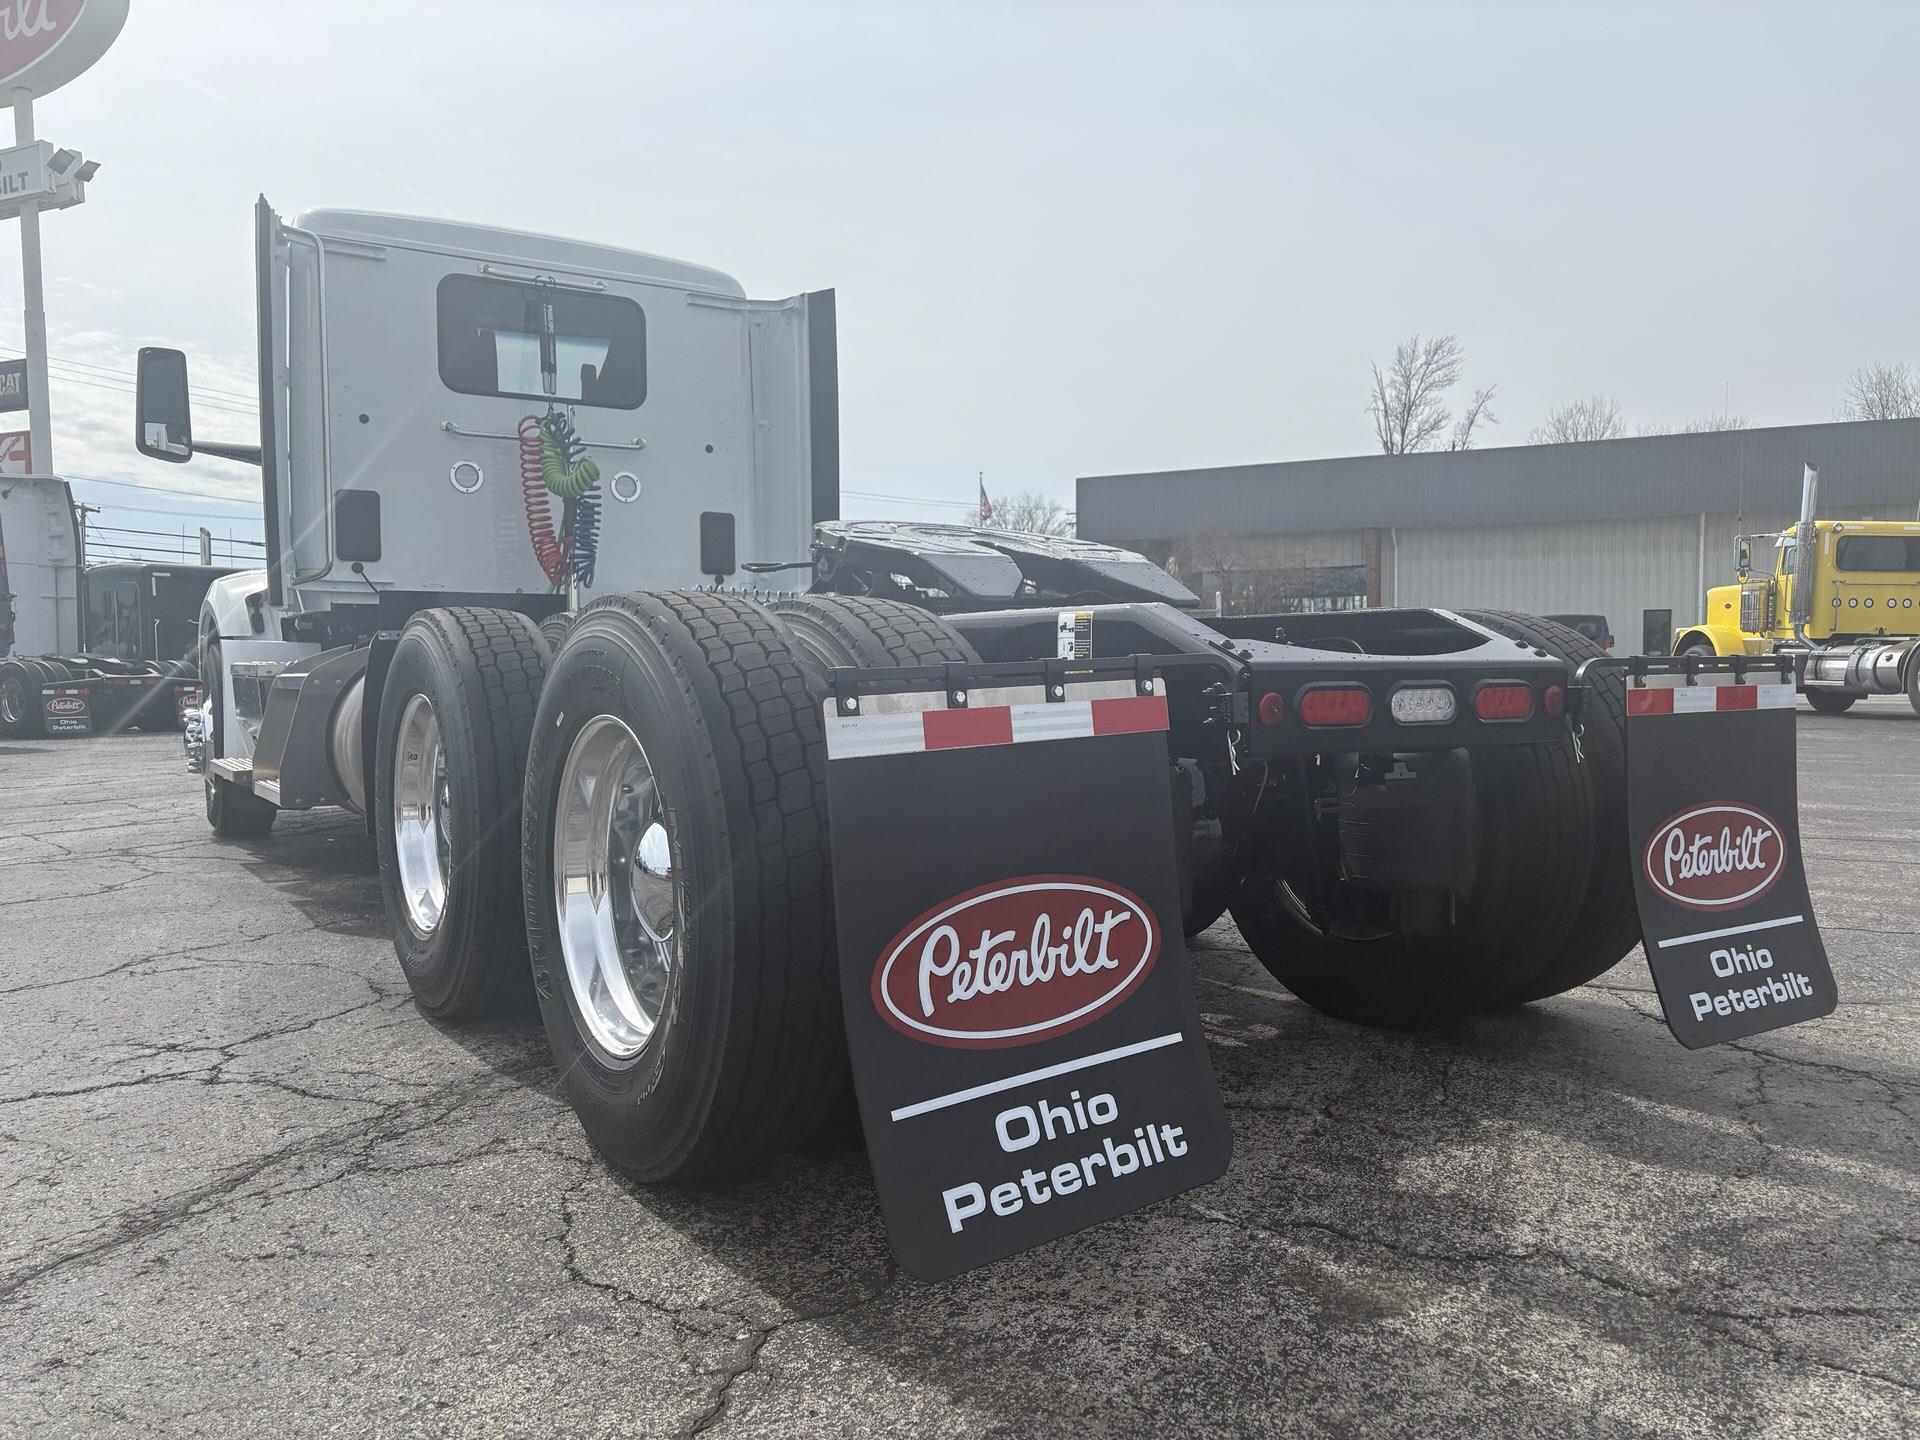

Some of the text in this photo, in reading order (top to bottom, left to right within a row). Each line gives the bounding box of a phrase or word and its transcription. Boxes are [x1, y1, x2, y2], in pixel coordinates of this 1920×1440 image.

[0, 171, 28, 195] ILT
[1663, 825, 1772, 886] Peterbilt
[918, 907, 1131, 1018] Peterbilt
[1710, 944, 1774, 978] Ohio
[1689, 972, 1813, 1022] Peterbilt
[994, 1089, 1119, 1154] Ohio
[941, 1121, 1188, 1235] Peterbilt
